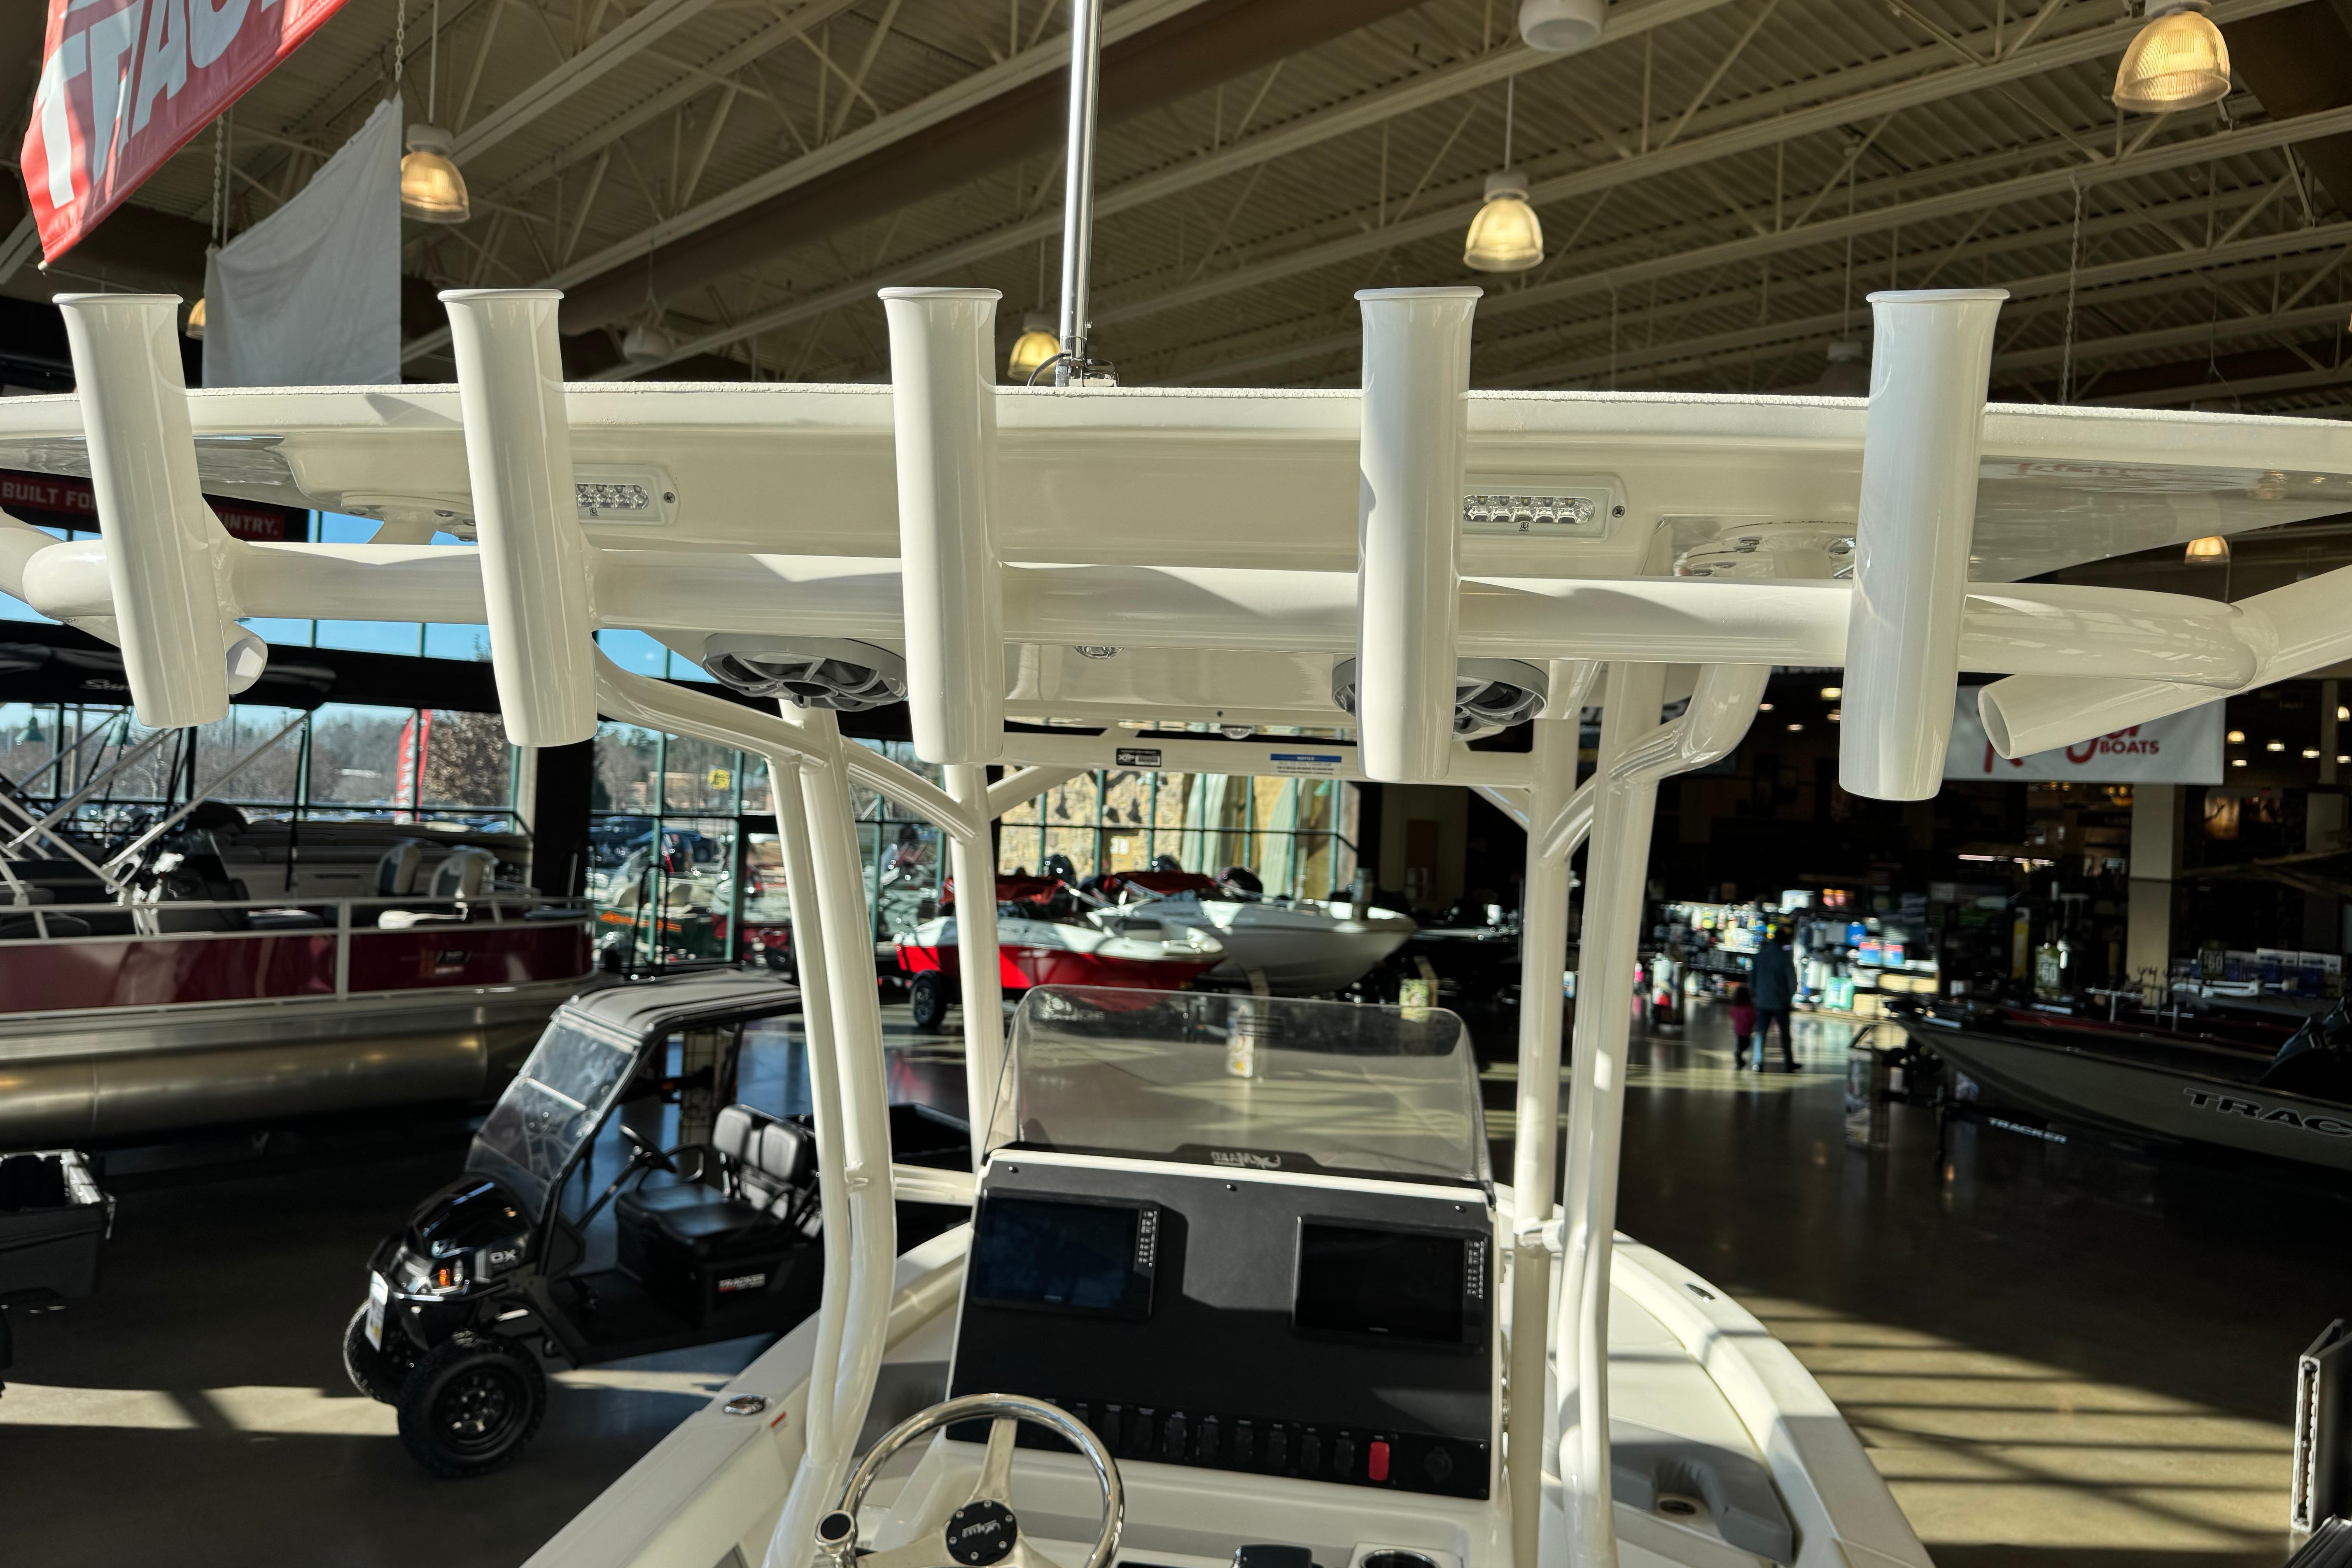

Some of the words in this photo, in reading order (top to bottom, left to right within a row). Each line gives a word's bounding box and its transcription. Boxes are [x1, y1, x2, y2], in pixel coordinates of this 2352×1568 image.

[37, 0, 280, 210] TRAC
[2, 481, 59, 505] BUILT
[2100, 740, 2160, 754] BOATS
[1987, 1117, 2068, 1144] TRACKER
